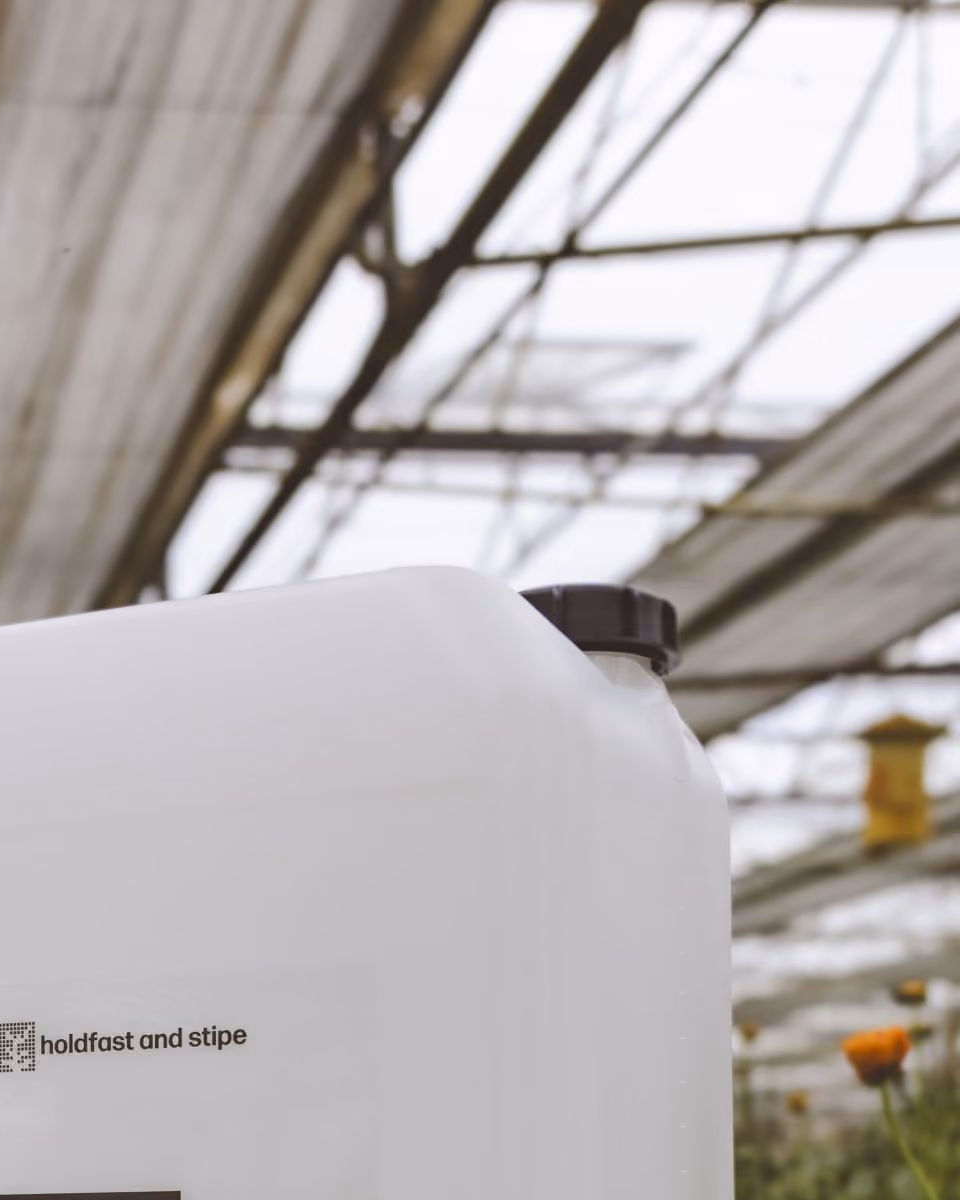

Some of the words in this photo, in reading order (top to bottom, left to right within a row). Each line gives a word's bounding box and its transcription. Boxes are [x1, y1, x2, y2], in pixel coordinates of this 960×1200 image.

[40, 1031, 135, 1055] holdfast
[139, 1027, 183, 1050] and
[188, 1025, 248, 1051] stipe
